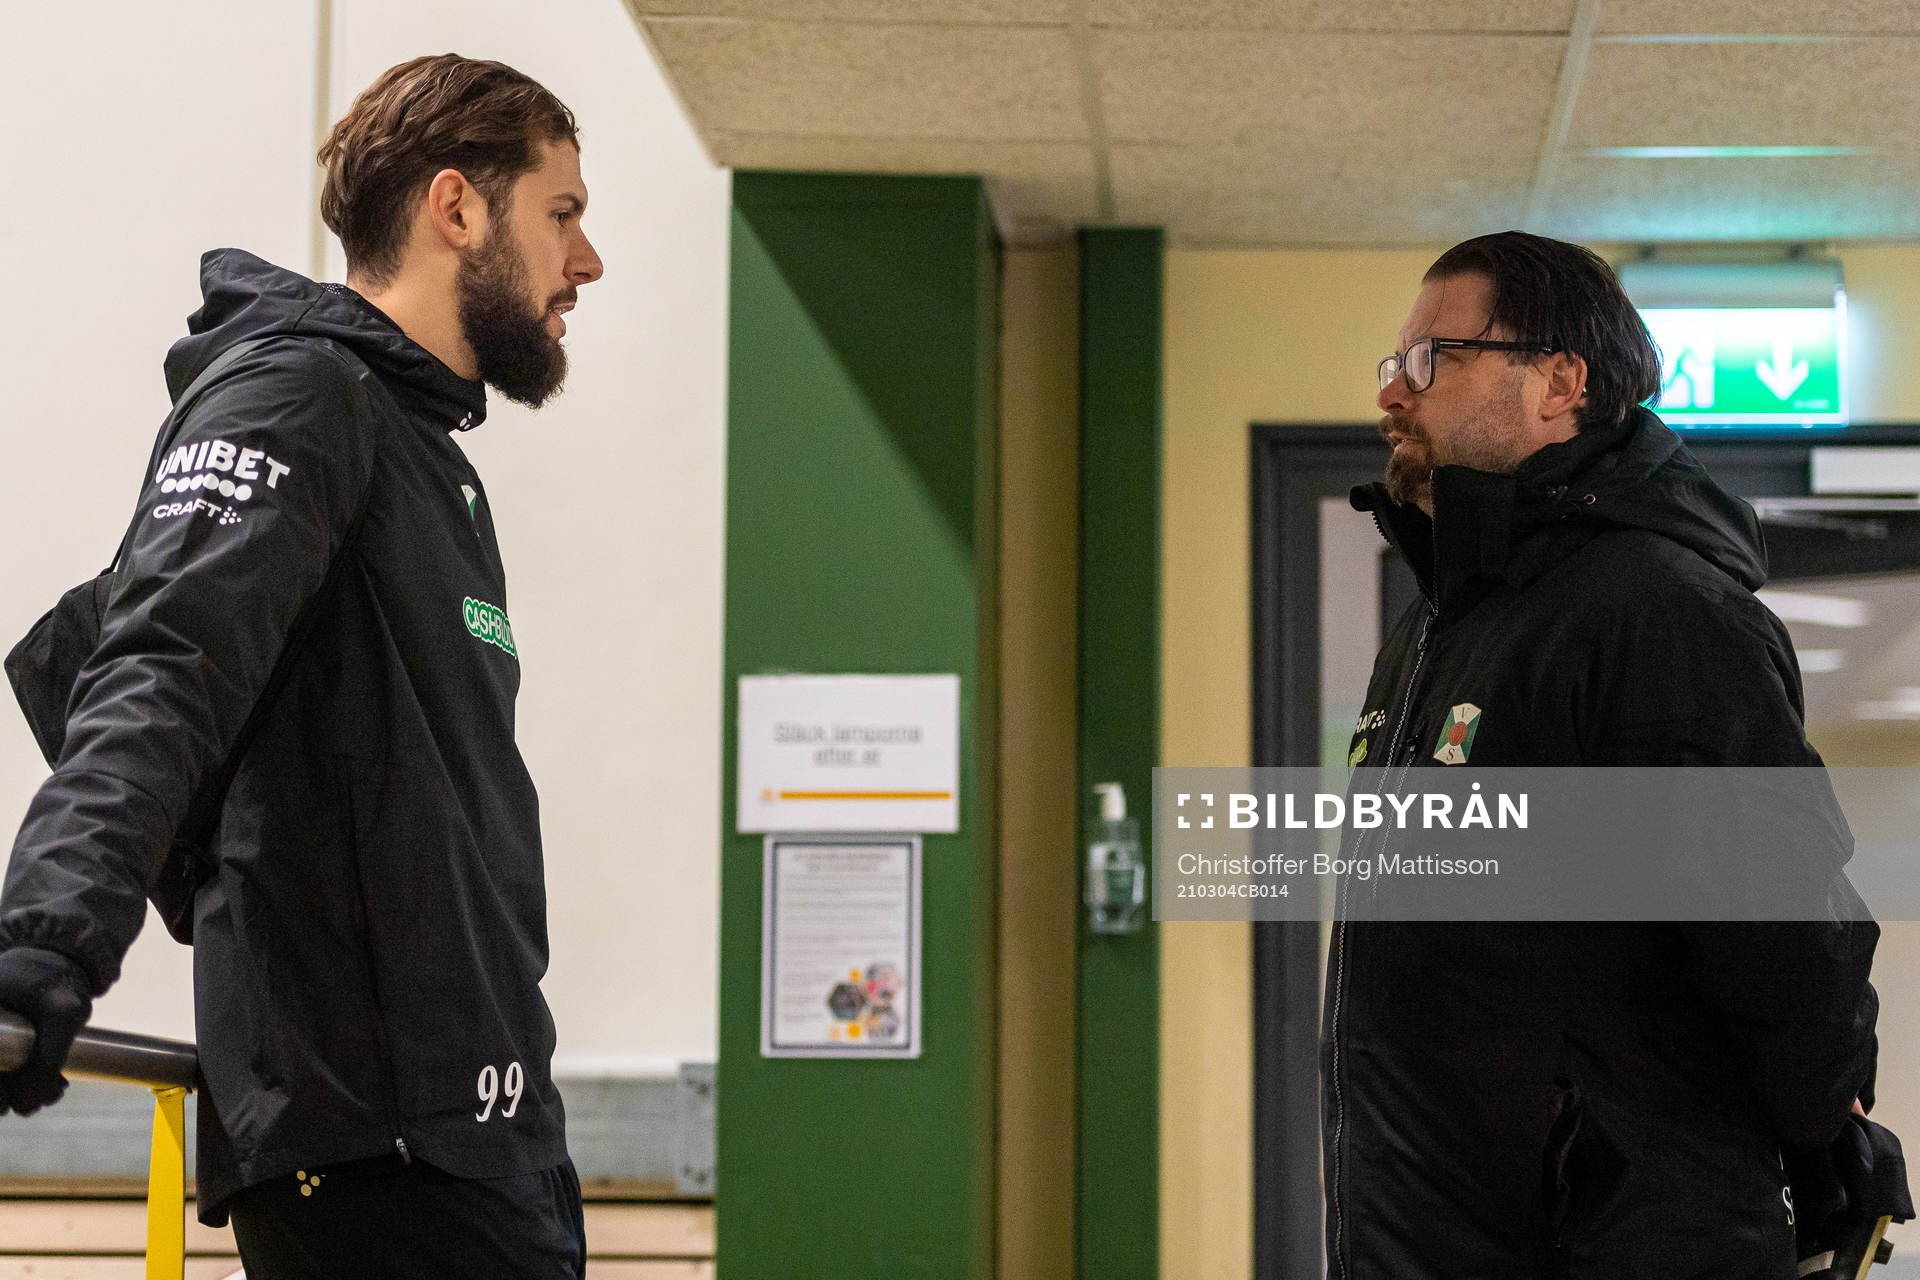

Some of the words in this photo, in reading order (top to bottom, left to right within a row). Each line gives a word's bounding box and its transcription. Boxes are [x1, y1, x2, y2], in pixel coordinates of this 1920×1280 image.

[155, 439, 291, 489] UNIBET
[153, 498, 222, 519] CRAFT
[475, 1061, 524, 1123] 99
